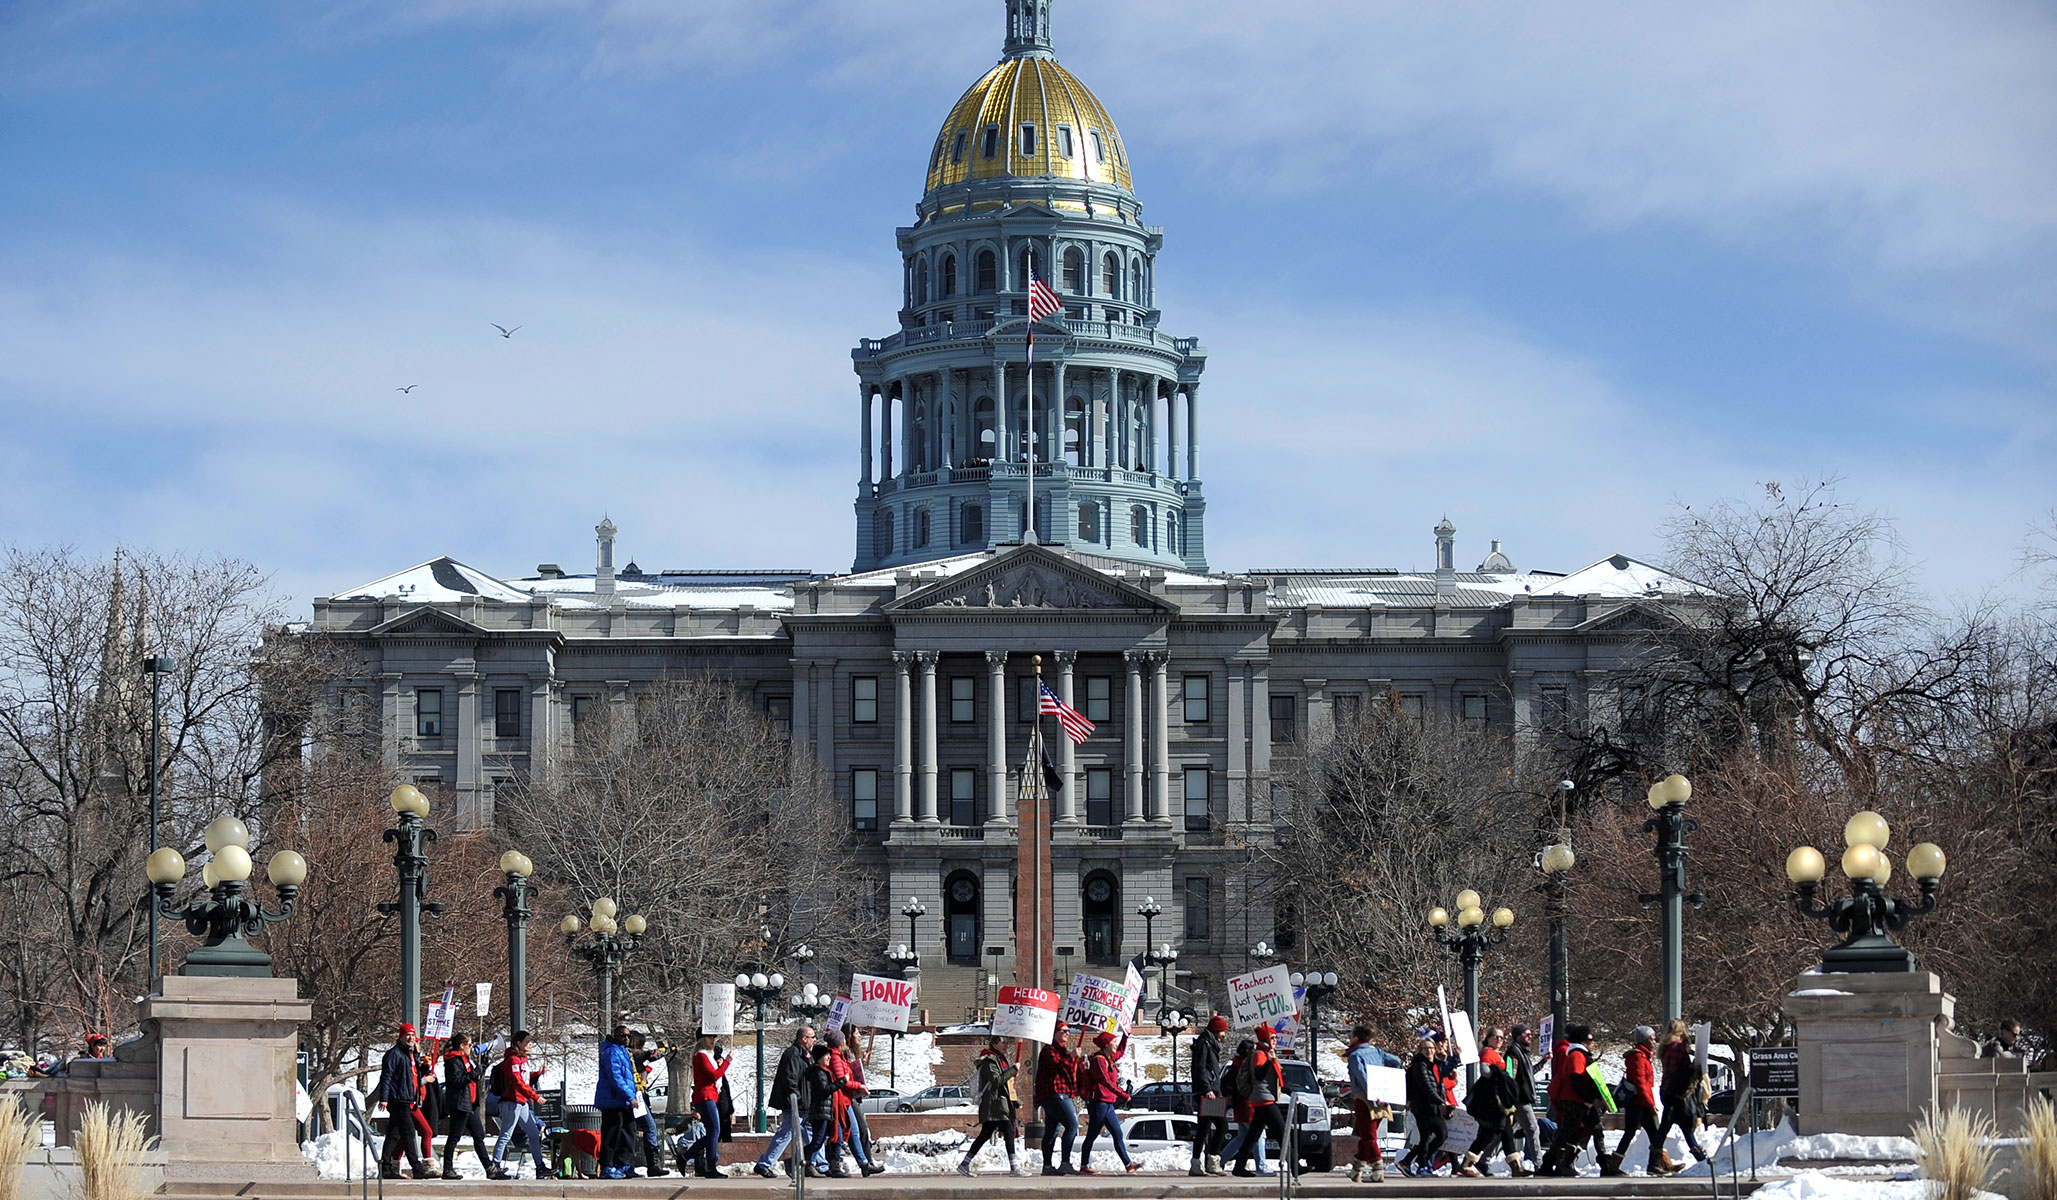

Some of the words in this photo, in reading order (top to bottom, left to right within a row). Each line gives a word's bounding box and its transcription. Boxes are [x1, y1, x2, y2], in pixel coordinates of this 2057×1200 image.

[1230, 972, 1274, 992] Teachers
[861, 980, 913, 1007] HONK
[1013, 987, 1048, 1002] HELLO
[1081, 985, 1126, 1010] STRONGER
[1009, 1006, 1024, 1016] DPS
[1065, 1007, 1108, 1030] POWER
[1237, 1010, 1260, 1024] have
[1752, 1052, 1772, 1060] Grass
[1773, 1052, 1788, 1060] Area
